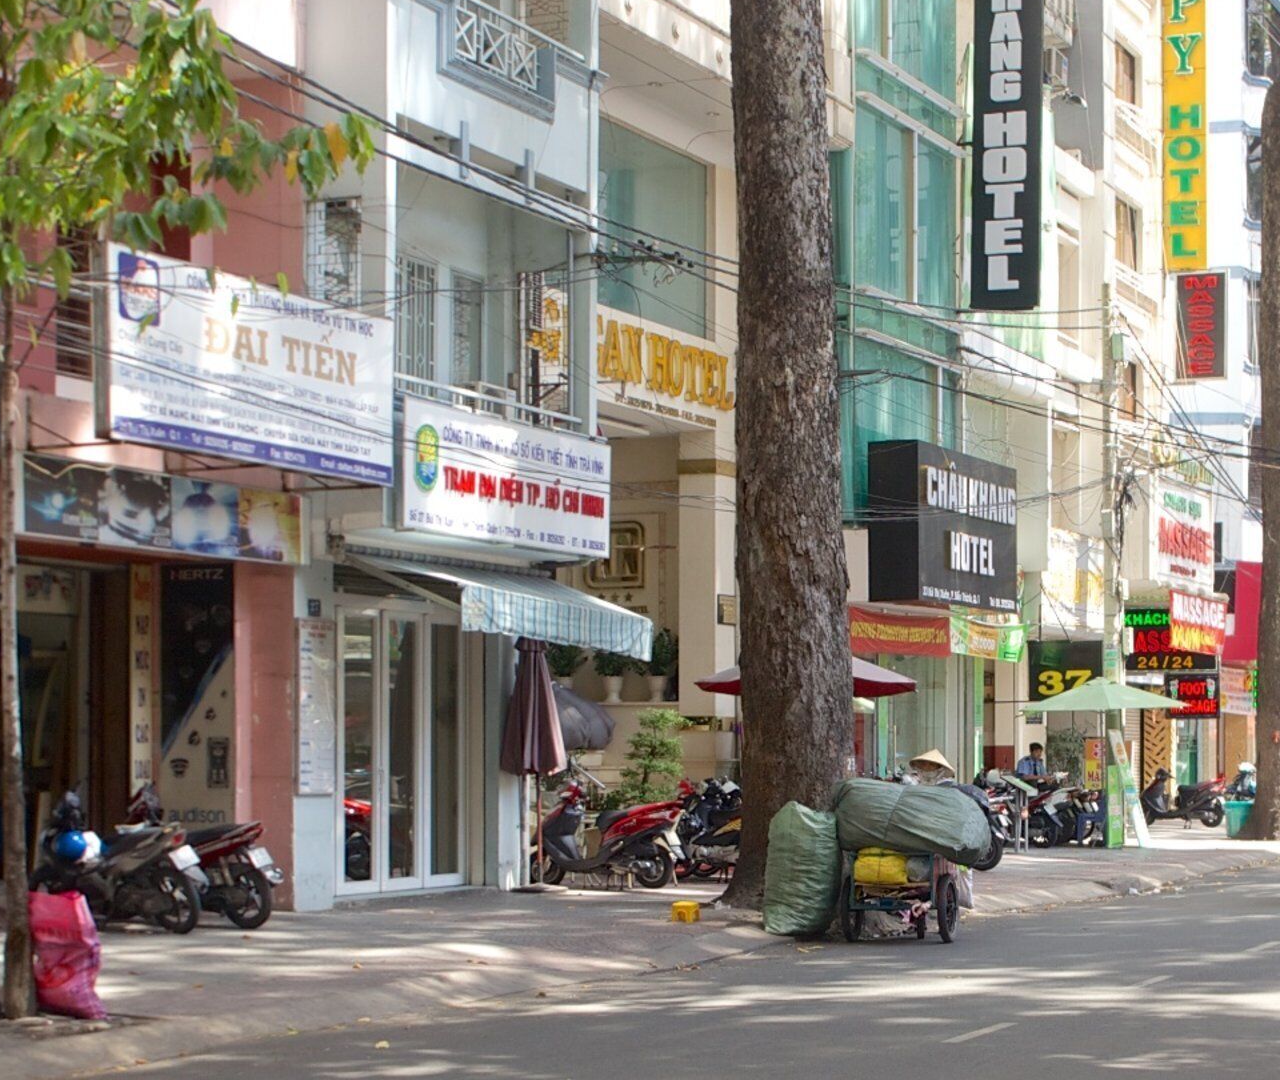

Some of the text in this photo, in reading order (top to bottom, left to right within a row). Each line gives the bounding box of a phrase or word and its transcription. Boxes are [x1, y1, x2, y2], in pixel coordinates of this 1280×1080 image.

[982, 110, 1028, 291] HOTEL
[1167, 104, 1202, 257] HOTEL
[1183, 275, 1218, 375] MASSAGE
[282, 330, 357, 386] TIẾN
[646, 332, 735, 411] HOTEL
[443, 465, 476, 497] TRẠM
[969, 478, 1017, 526] KHANG
[170, 568, 224, 580] HERTZ
[950, 531, 995, 577] HOTEL
[1172, 592, 1226, 629] MASSAGE
[1038, 670, 1092, 695] 37
[1180, 682, 1206, 695] FOOT
[168, 807, 225, 823] audison
